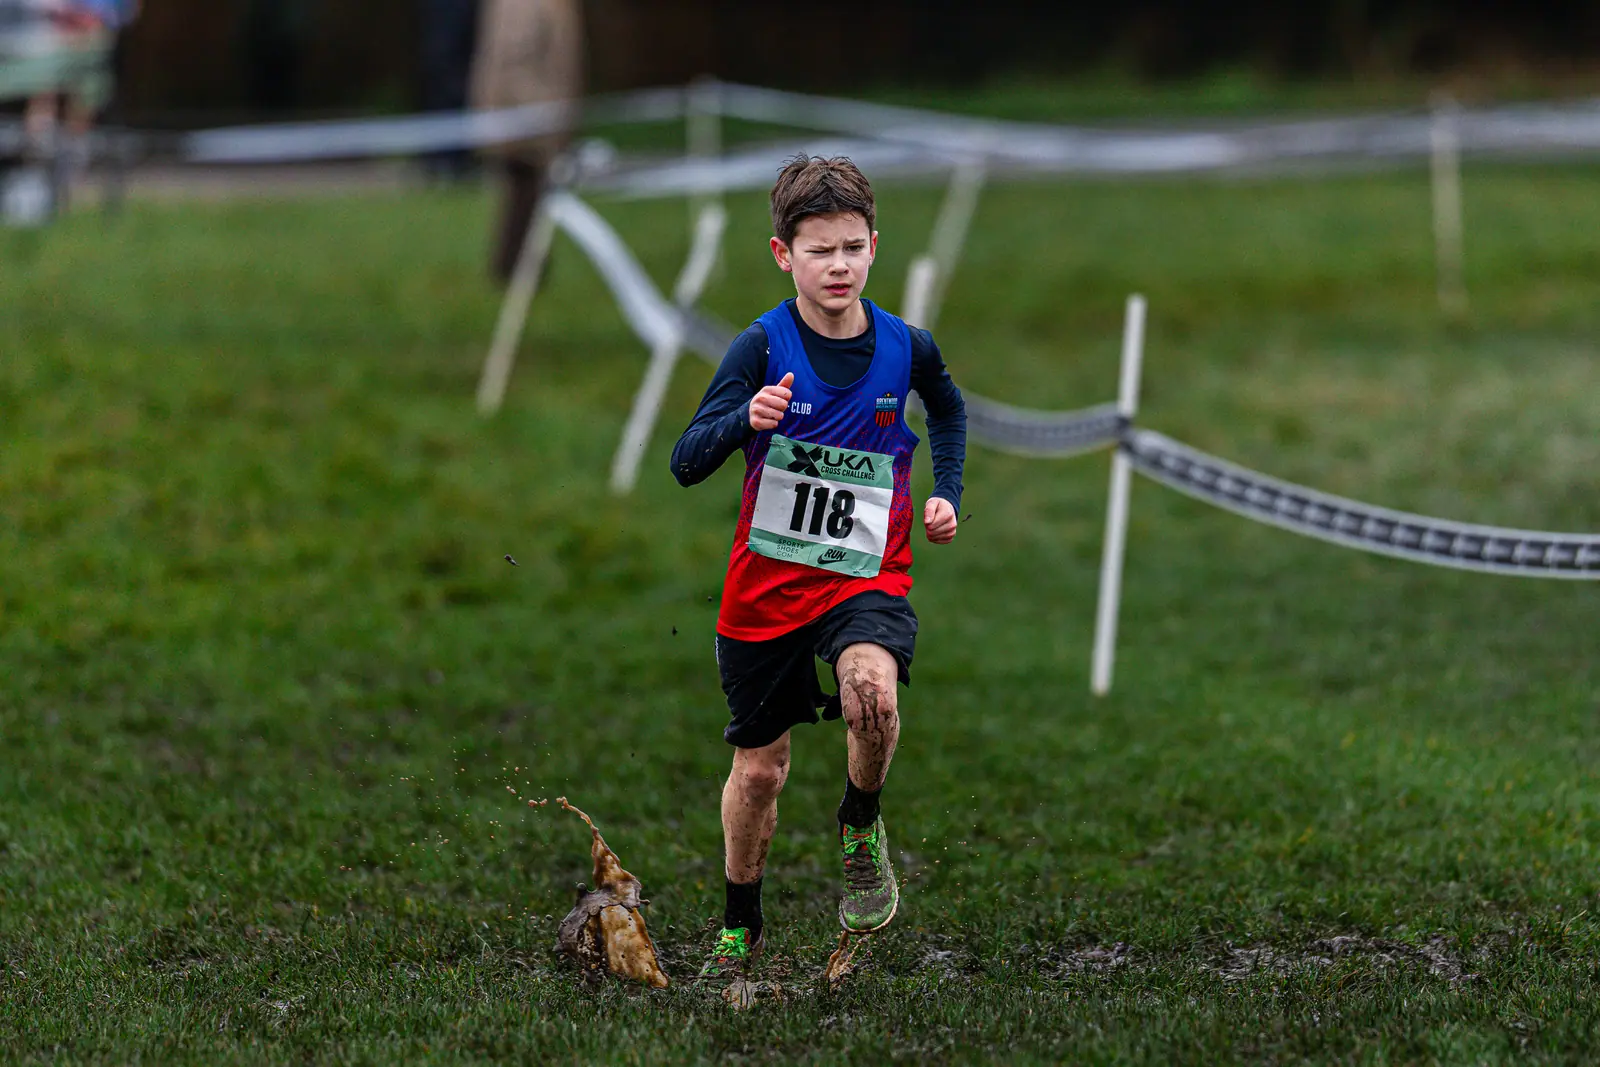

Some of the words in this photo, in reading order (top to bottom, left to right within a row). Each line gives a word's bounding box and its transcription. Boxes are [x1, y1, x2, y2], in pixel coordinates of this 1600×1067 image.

[790, 401, 812, 415] CLUB
[820, 465, 841, 476] CROSS
[841, 469, 876, 481] CHALLENGE
[789, 482, 856, 540] 118
[776, 544, 799, 555] SHOES
[778, 538, 806, 550] SPORTS
[823, 548, 848, 561] RUN
